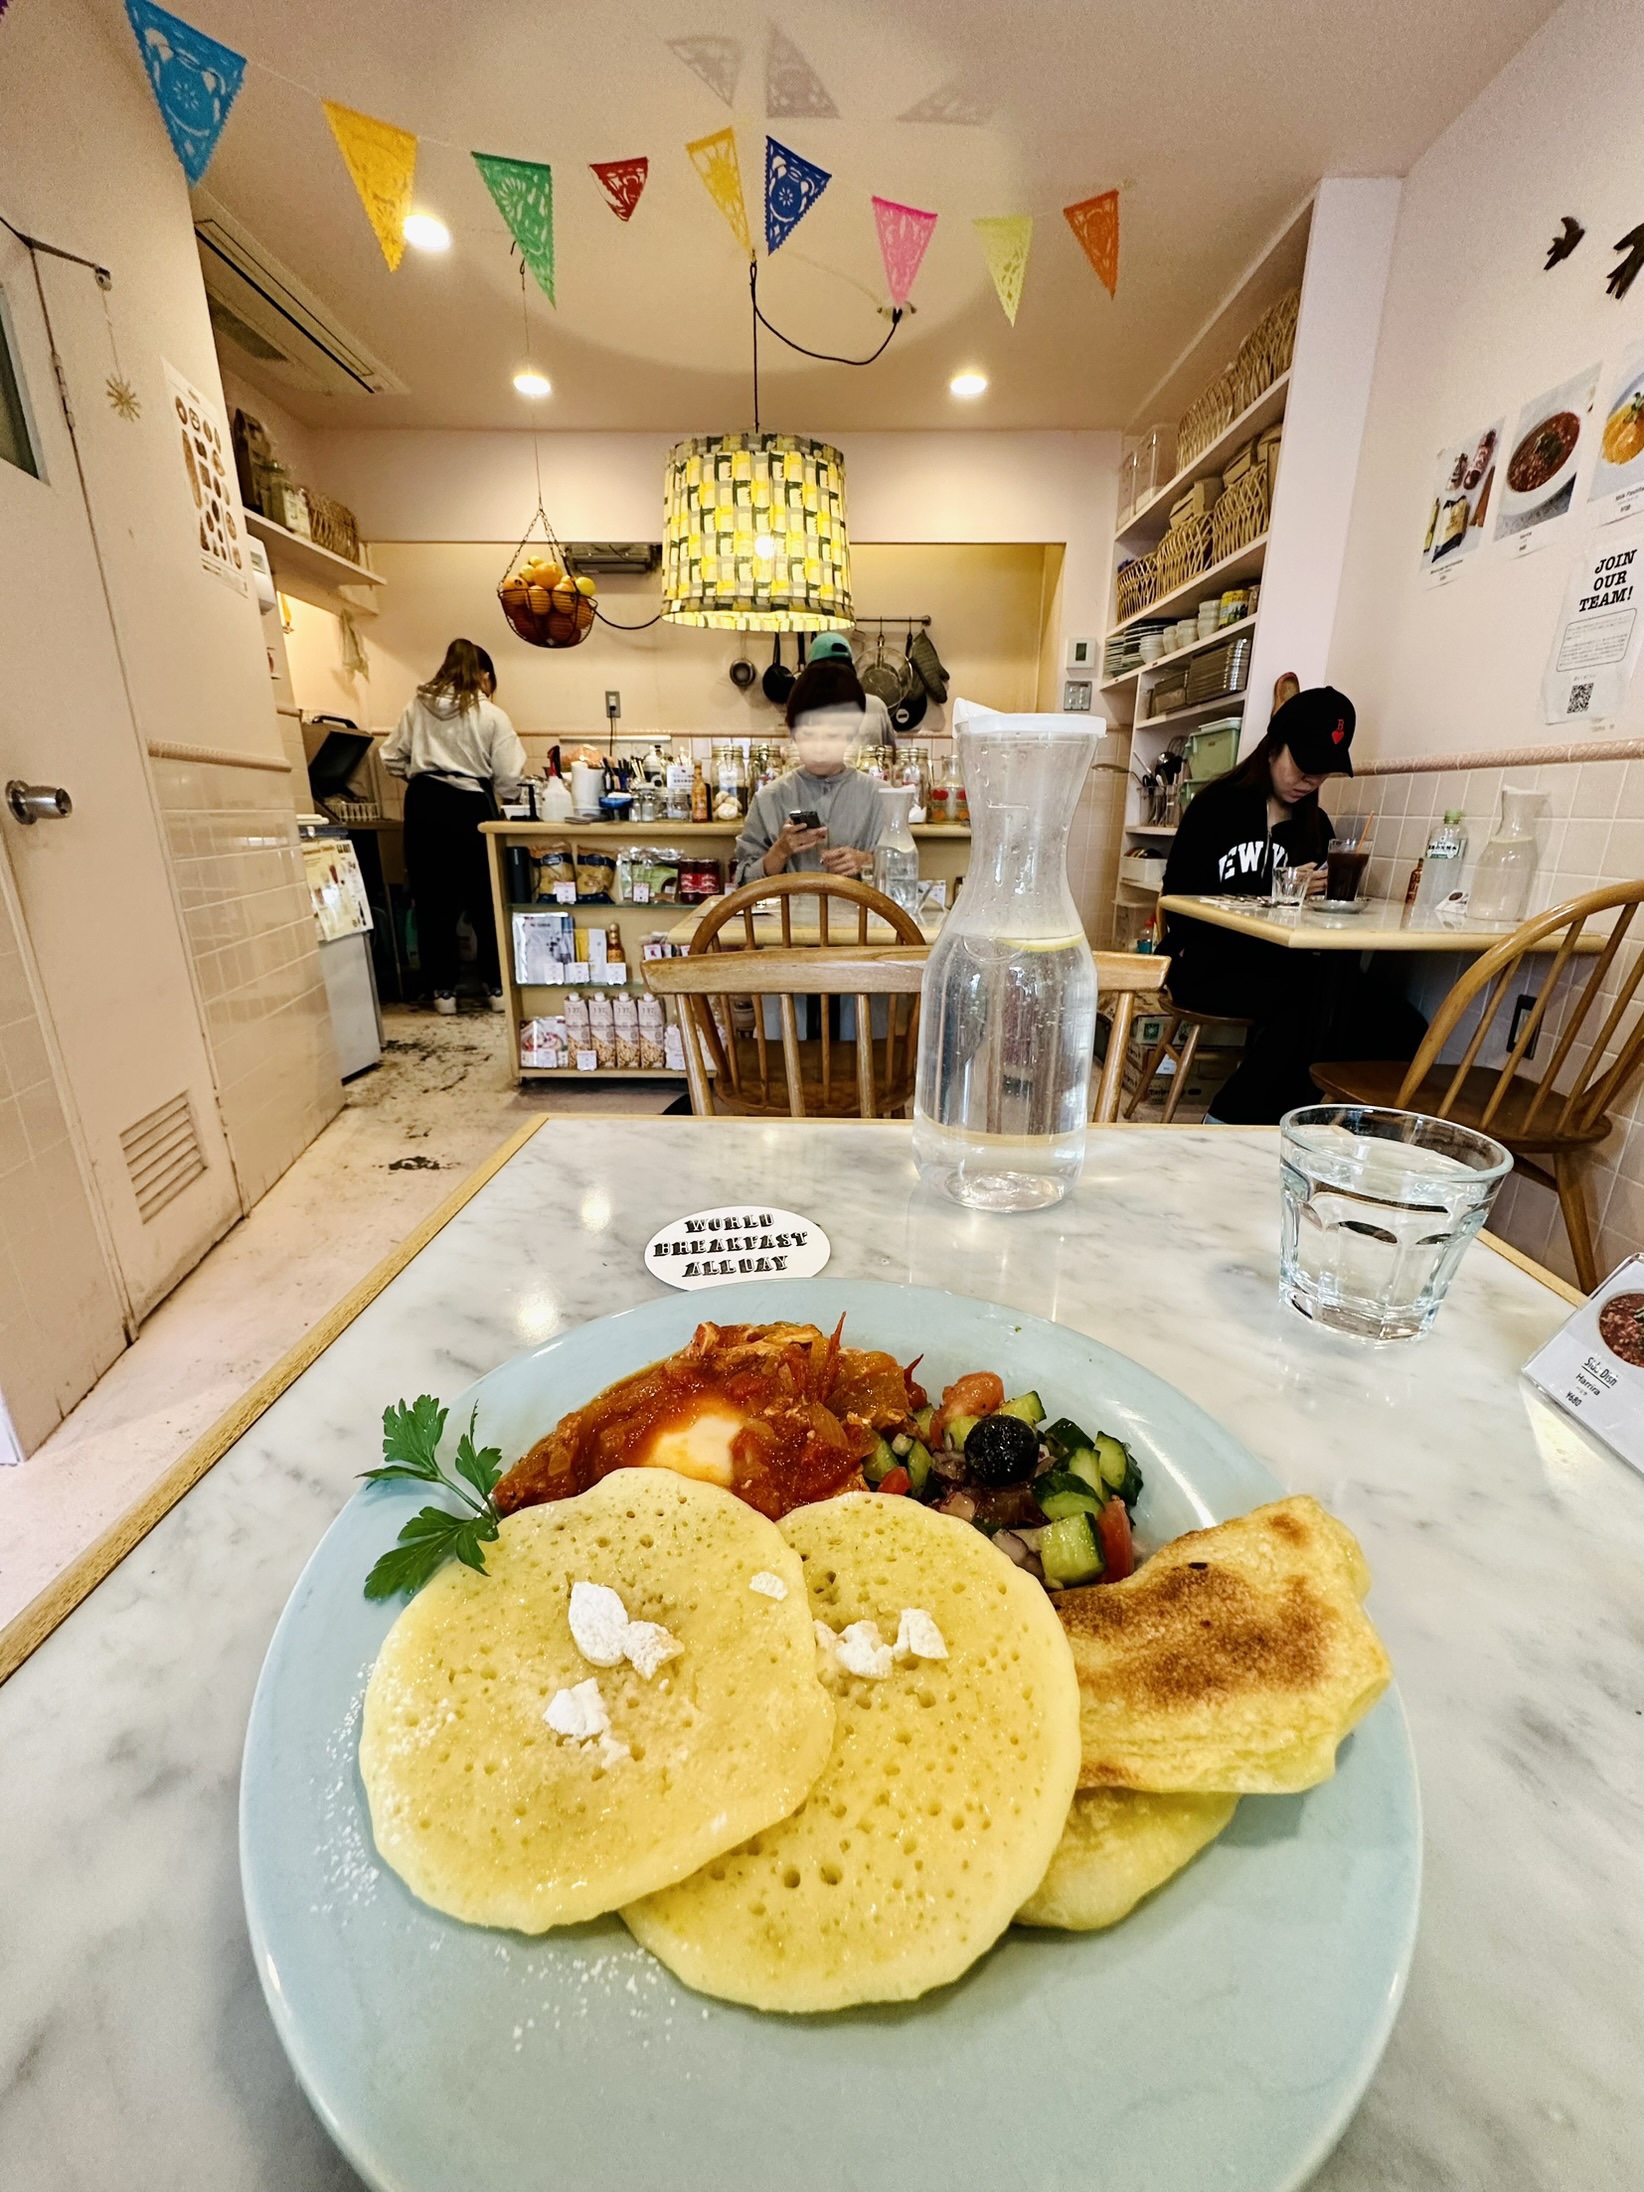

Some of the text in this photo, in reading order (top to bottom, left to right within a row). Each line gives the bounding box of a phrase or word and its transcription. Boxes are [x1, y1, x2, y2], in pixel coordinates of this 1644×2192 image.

[1594, 549, 1638, 574] JOIN
[1593, 570, 1627, 592] OUR
[1578, 586, 1634, 612] TEAM!
[1337, 719, 1345, 731] B
[684, 1213, 775, 1233] WORLD
[653, 1232, 808, 1257] BREAKFAST
[1575, 1373, 1601, 1396] Harrira
